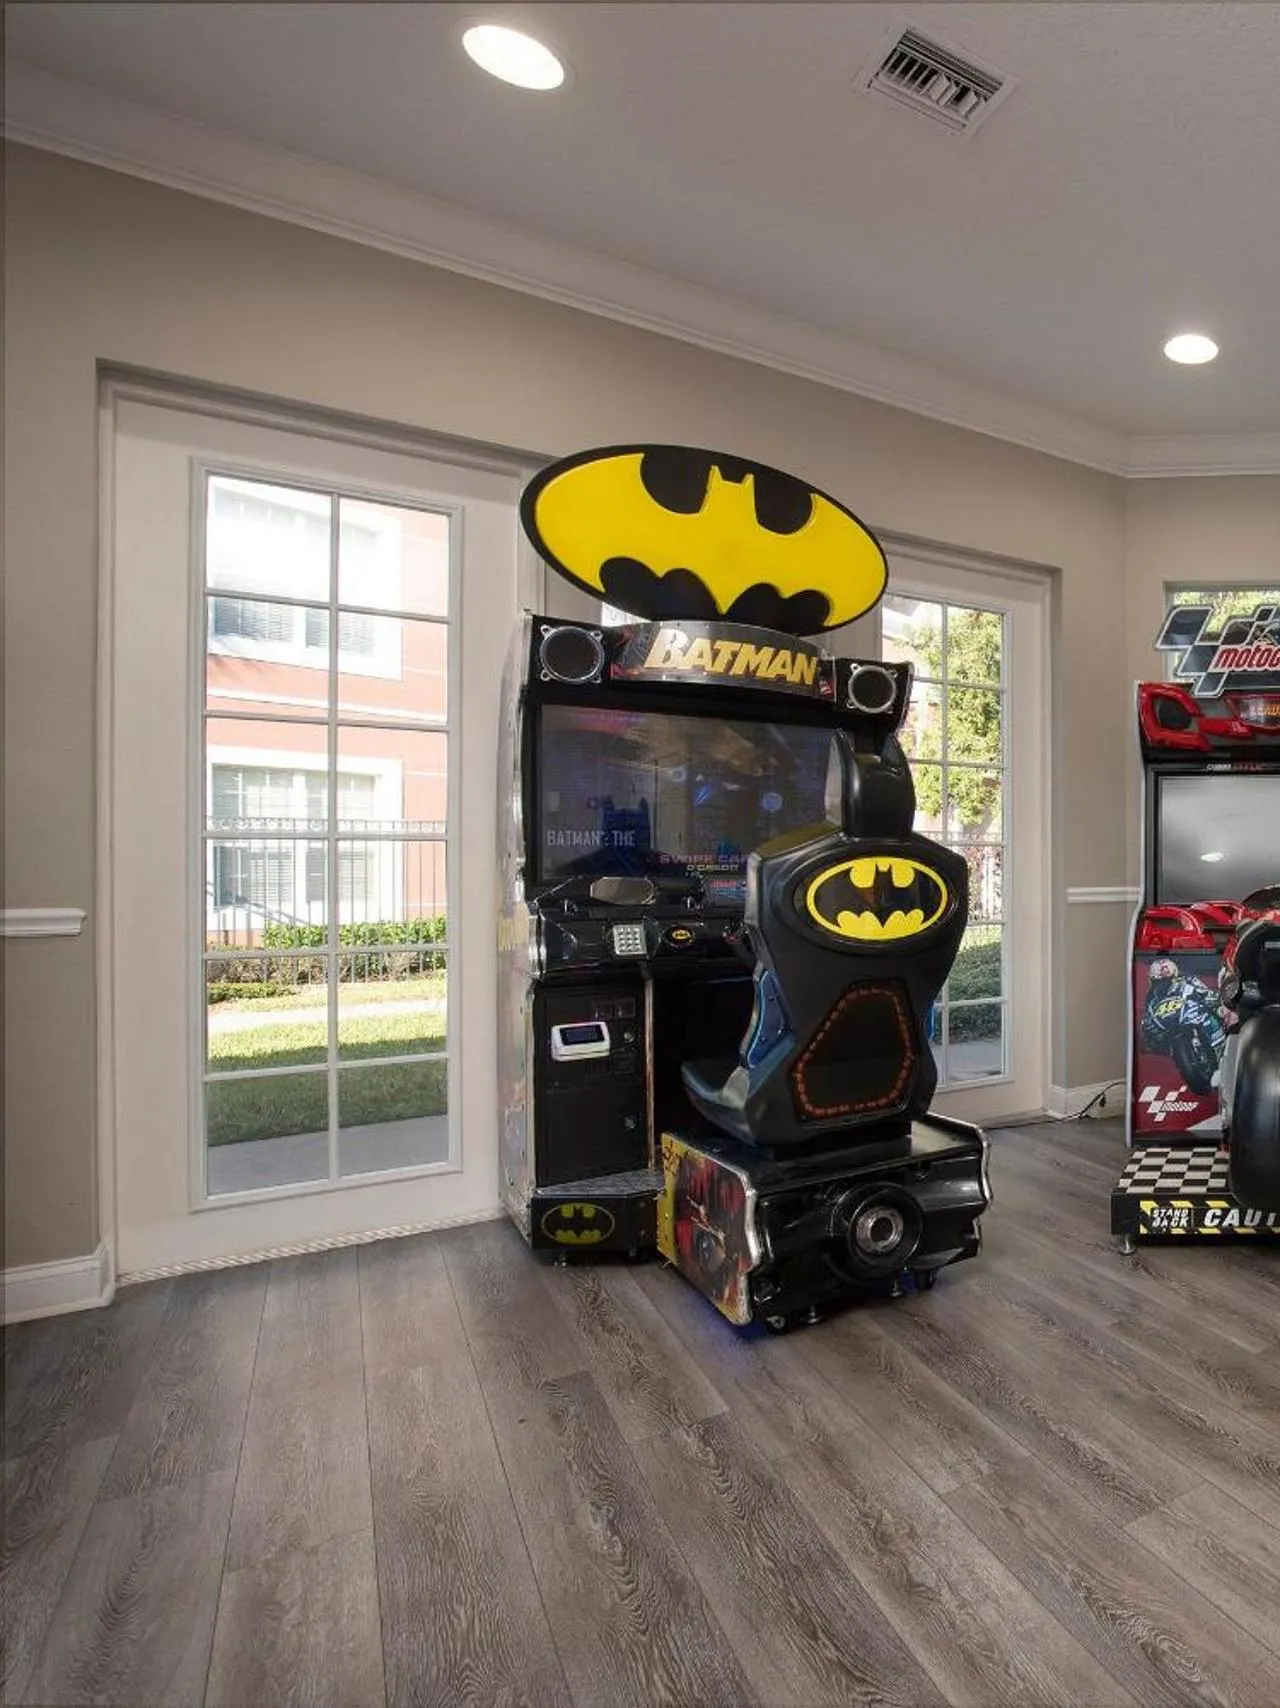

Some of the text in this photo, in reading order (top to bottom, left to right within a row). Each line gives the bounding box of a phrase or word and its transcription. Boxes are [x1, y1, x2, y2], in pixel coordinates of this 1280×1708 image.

[644, 628, 817, 685] BATMAN
[612, 830, 635, 846] THE
[718, 854, 750, 864] CAR
[1152, 1208, 1188, 1217] STAND
[1152, 1217, 1188, 1227] BACK
